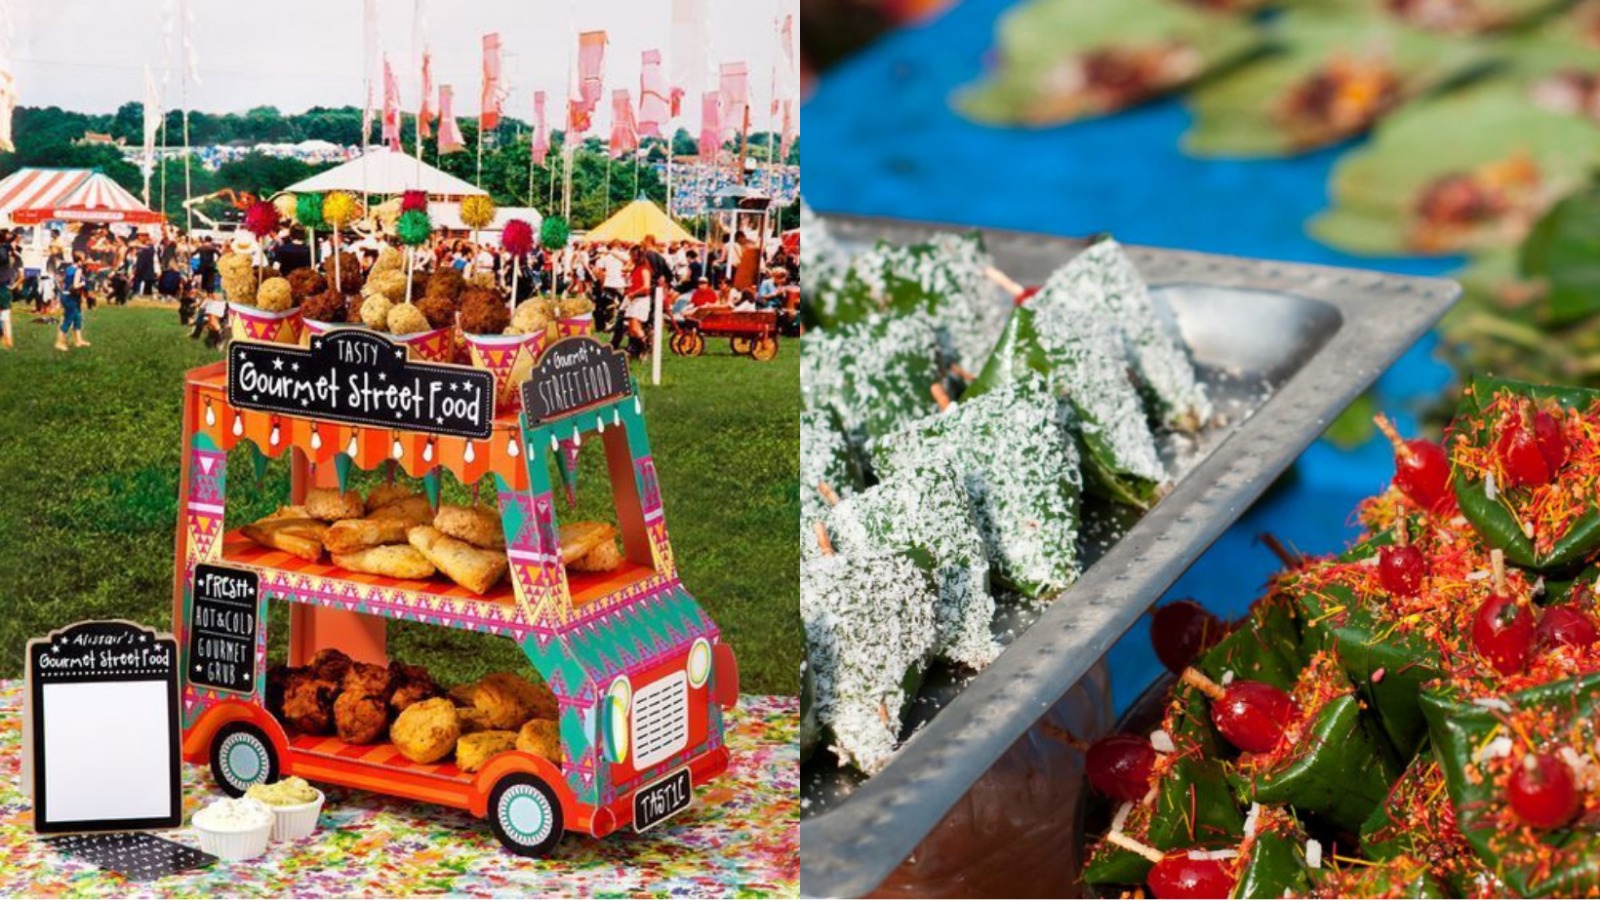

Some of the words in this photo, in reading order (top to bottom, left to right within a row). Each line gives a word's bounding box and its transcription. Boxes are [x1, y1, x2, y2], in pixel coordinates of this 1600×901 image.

[338, 340, 378, 365] TASTY
[553, 341, 588, 369] Gourmet
[239, 362, 340, 408] Gourmet
[348, 372, 424, 419] Street
[429, 381, 481, 426] Food
[538, 372, 582, 416] STREET
[582, 361, 612, 401] FOOD
[205, 573, 248, 599] FRESH
[39, 650, 96, 669] Gourmet
[100, 649, 141, 669] Street
[142, 649, 169, 667] Food
[197, 637, 247, 663] GOURMET
[207, 661, 236, 685] GRUB
